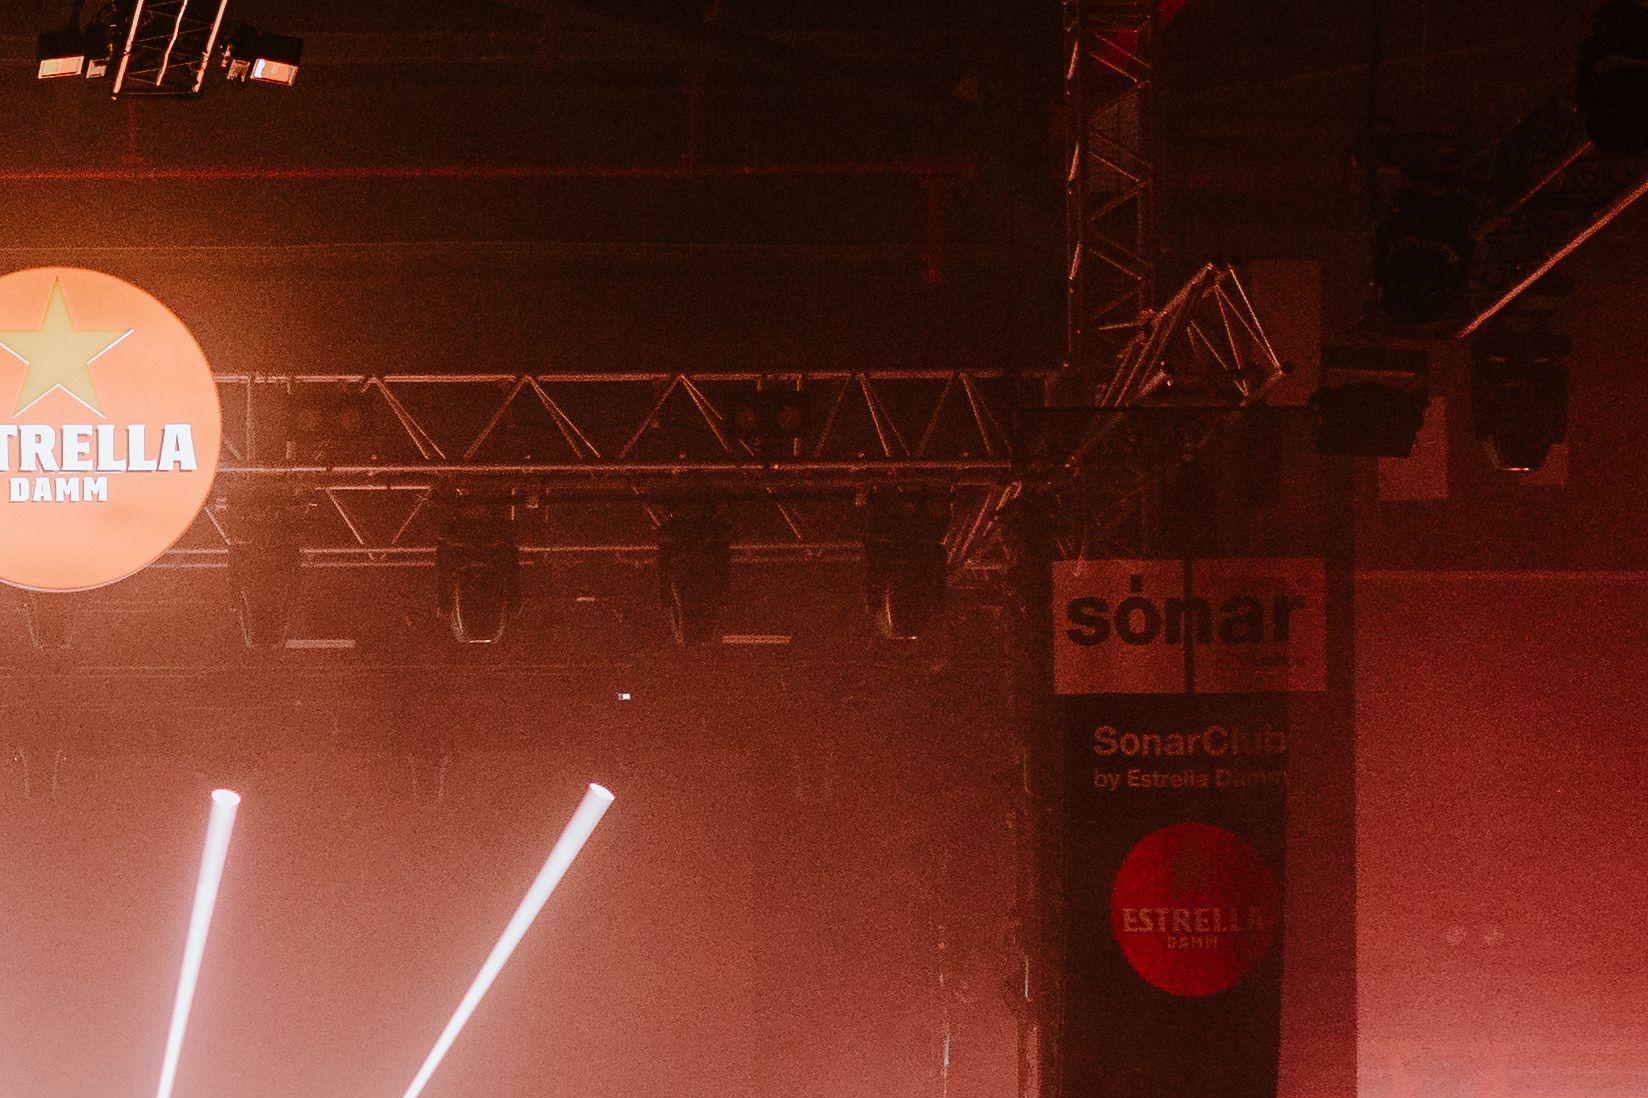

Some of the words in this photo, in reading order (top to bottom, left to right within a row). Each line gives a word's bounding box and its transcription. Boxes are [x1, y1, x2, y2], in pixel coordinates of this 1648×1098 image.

[9, 477, 108, 502] DAMM
[1093, 725, 1286, 756] SonarClub
[1093, 768, 1120, 791] by
[1127, 768, 1209, 788] Estrella
[1122, 907, 1265, 933] ESTRELLA
